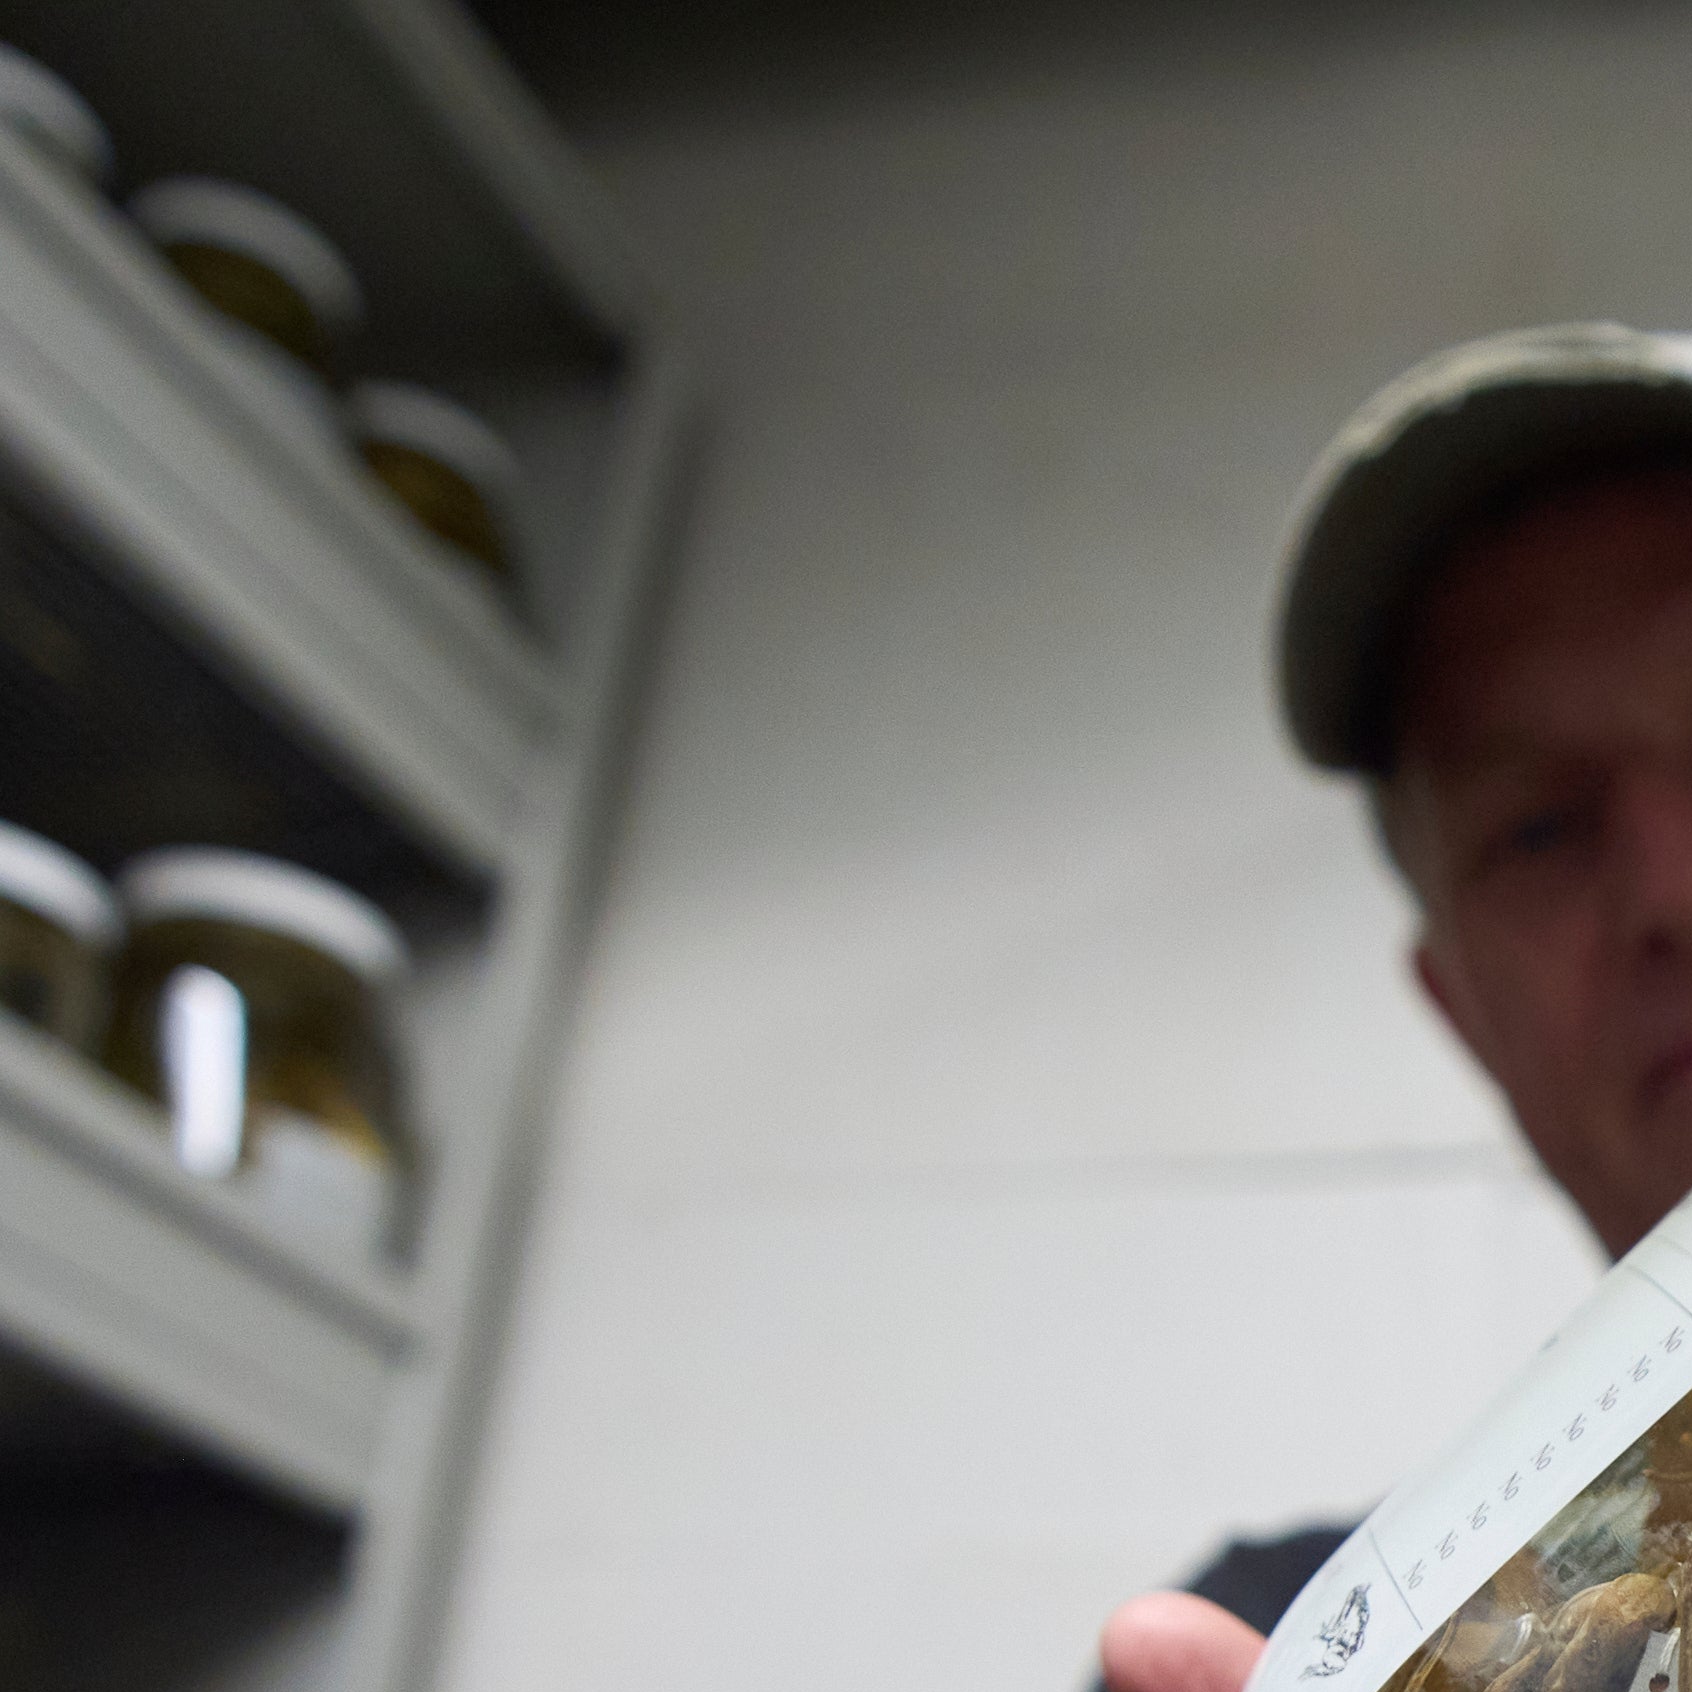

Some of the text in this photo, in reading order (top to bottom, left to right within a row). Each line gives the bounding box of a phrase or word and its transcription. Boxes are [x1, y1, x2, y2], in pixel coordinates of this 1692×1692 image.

[1660, 1326, 1684, 1353] No
[1627, 1355, 1651, 1382] No
[1597, 1384, 1619, 1411] No
[1563, 1413, 1586, 1441] No
[1530, 1442, 1554, 1470] No
[1498, 1471, 1522, 1500] No
[1467, 1500, 1490, 1530] No
[1435, 1530, 1458, 1560] No
[1403, 1559, 1427, 1589] No
